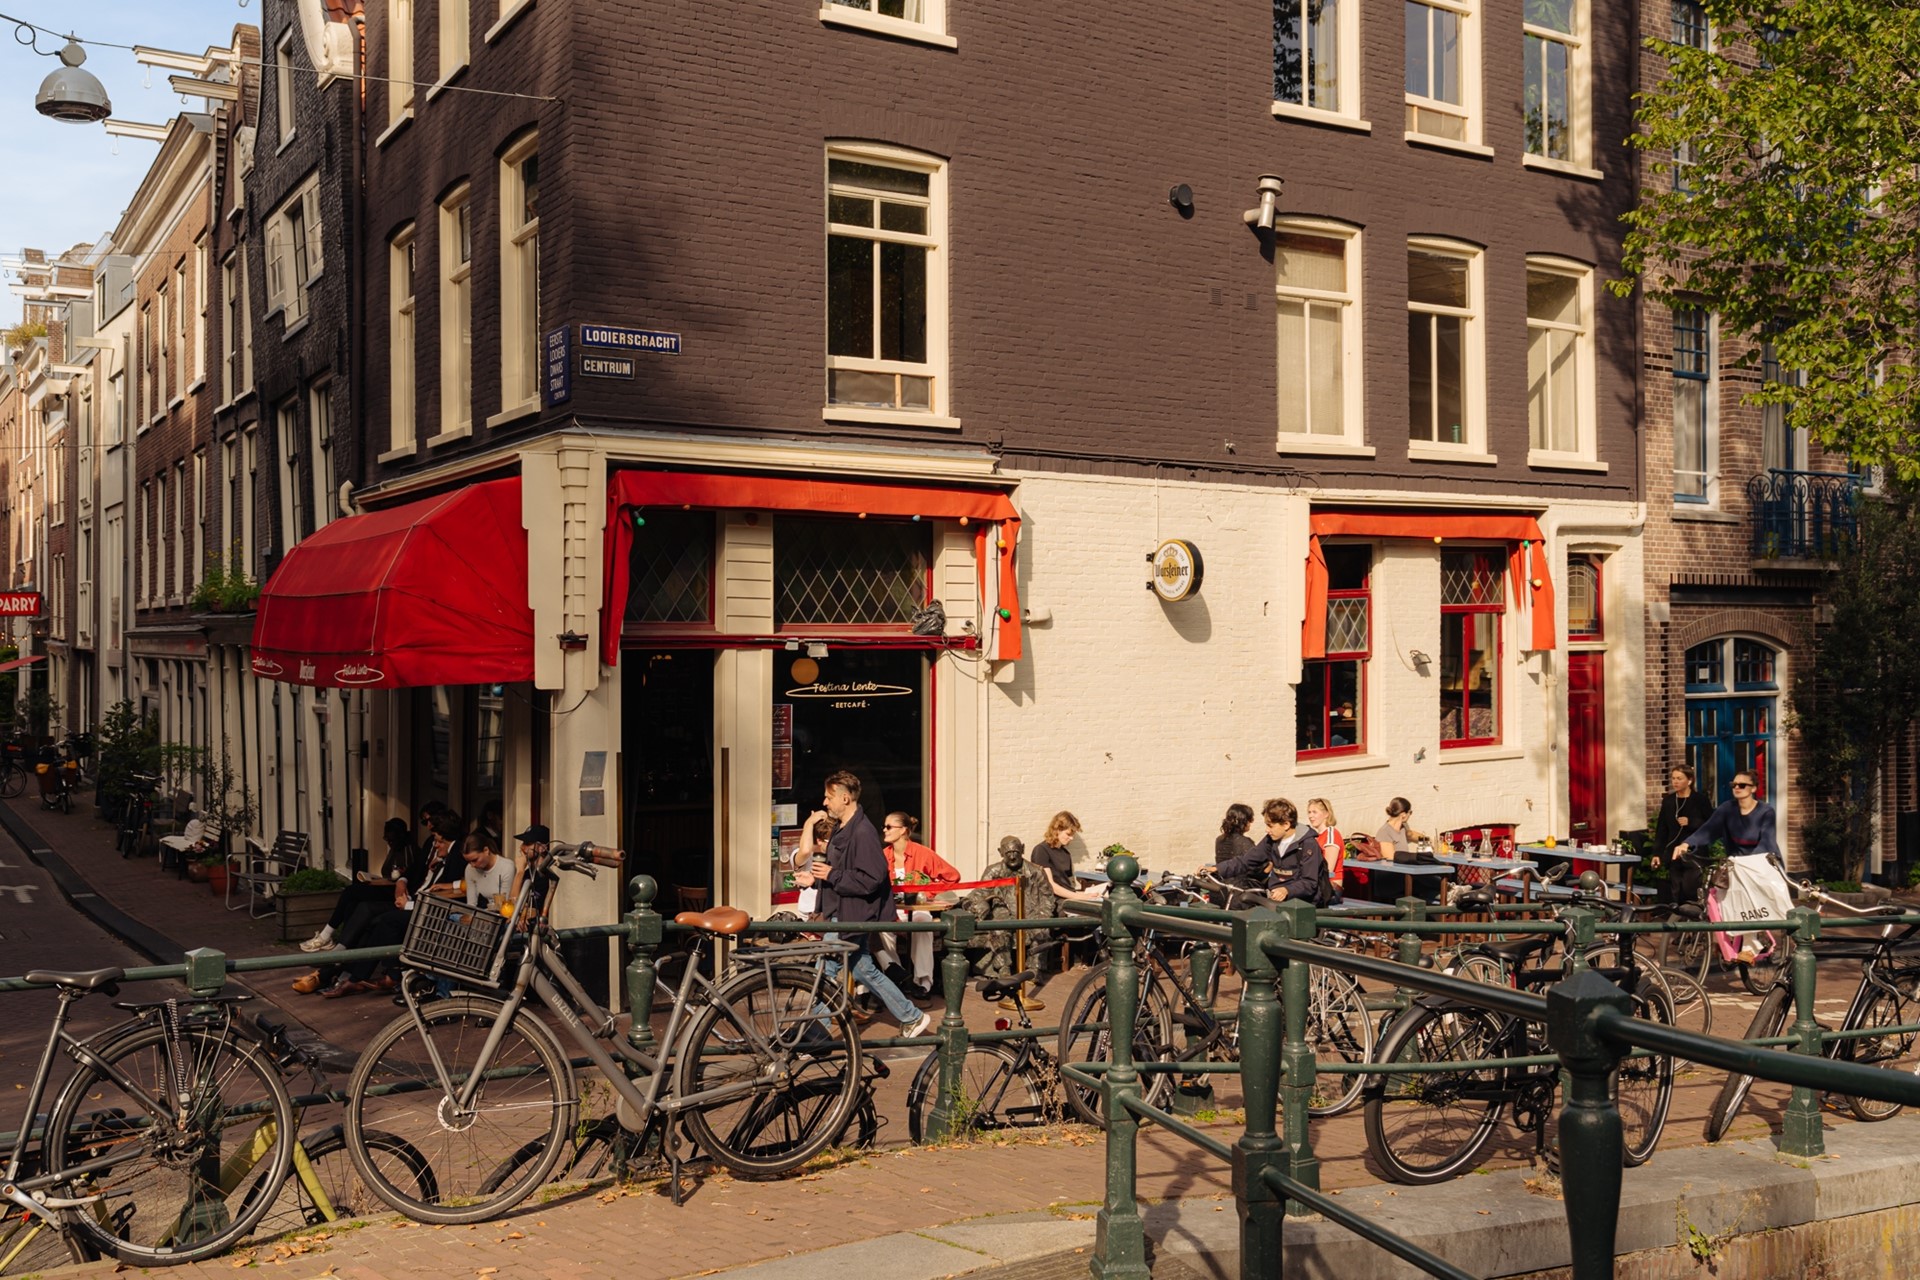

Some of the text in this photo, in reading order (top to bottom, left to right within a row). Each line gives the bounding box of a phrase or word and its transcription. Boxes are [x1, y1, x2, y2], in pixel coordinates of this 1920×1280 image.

[549, 331, 563, 348] EERSTE
[586, 329, 677, 350] LOOIERSGRACHT
[584, 359, 631, 375] CENTRUM
[1155, 562, 1189, 579] Warsteiner
[813, 681, 878, 693] Festina Lente
[551, 993, 579, 1029] GAZELLE
